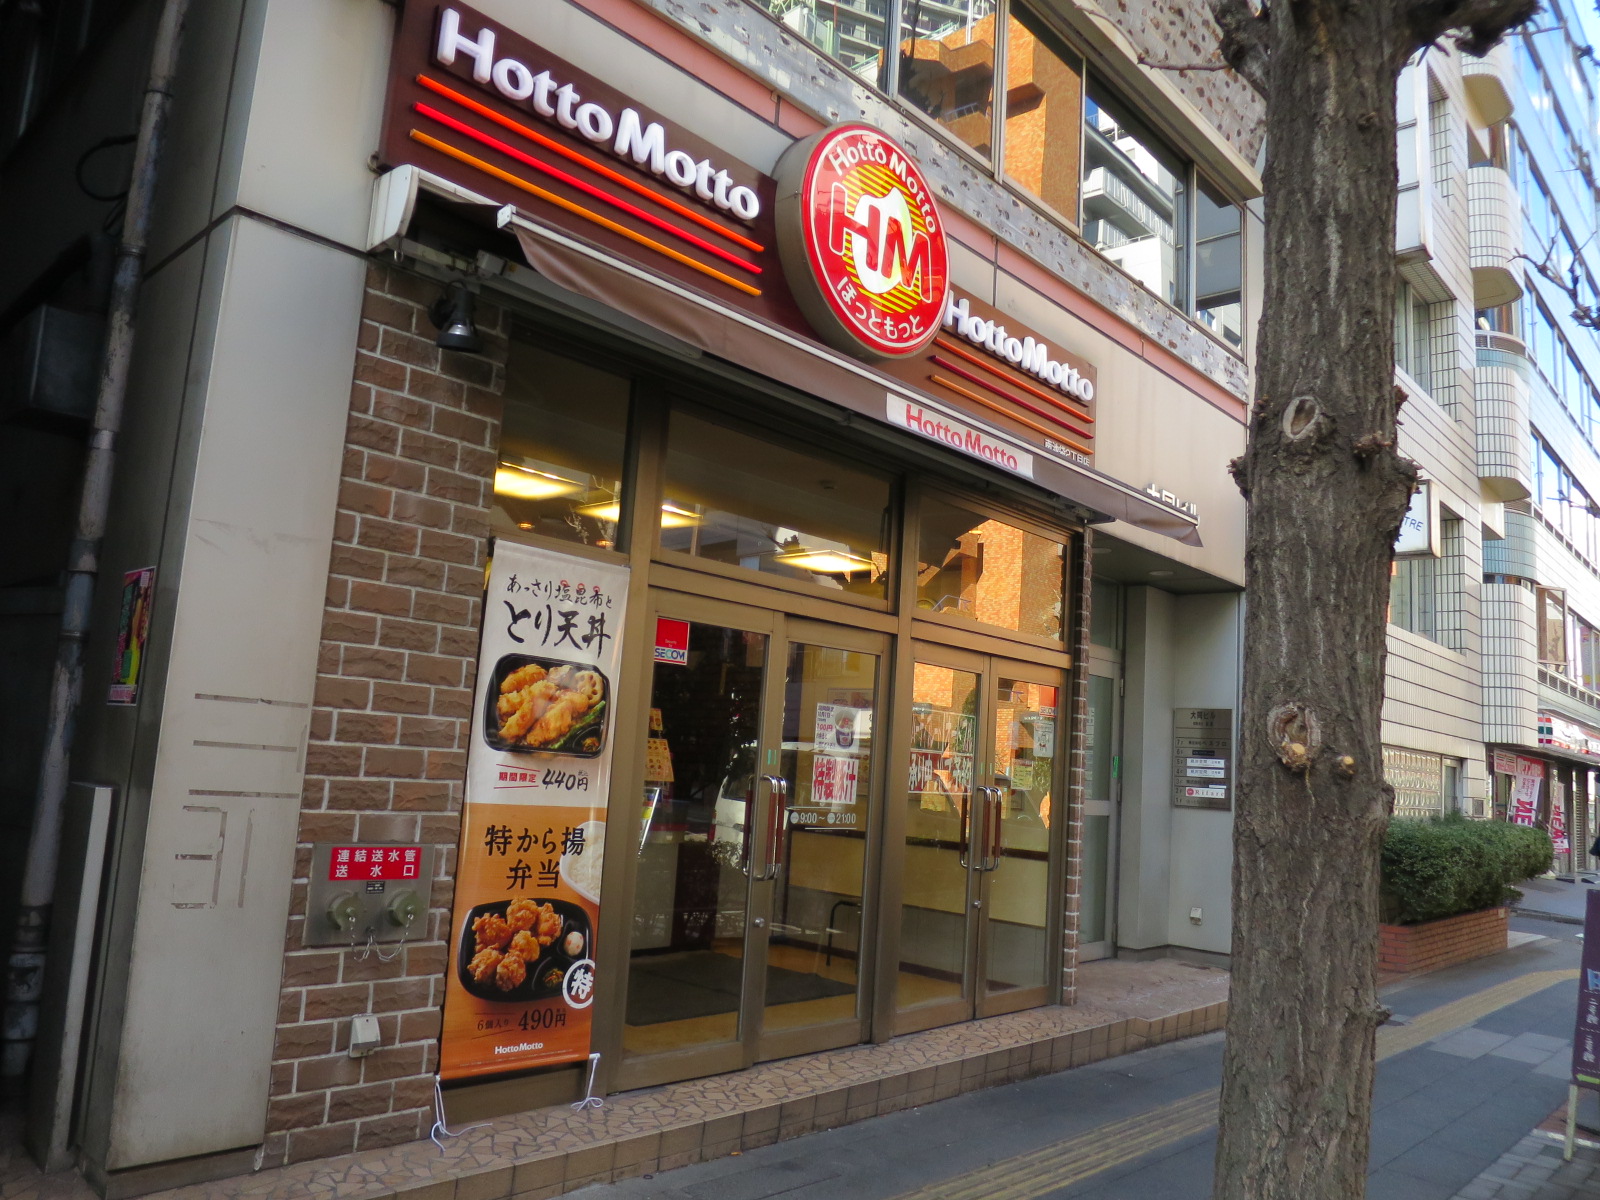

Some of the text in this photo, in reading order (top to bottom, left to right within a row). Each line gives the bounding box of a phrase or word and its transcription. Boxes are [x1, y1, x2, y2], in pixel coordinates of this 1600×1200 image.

[837, 276, 924, 339] ほっともっと
[507, 574, 612, 609] あっさり塩昆布と
[503, 600, 612, 660] とり天丼
[654, 647, 685, 661] SECOM
[800, 812, 817, 824] 9:00
[836, 812, 856, 824] 21:00
[1513, 798, 1534, 827] NE
[337, 849, 416, 862] 連結送水管
[484, 824, 586, 857] 特から揚
[506, 858, 561, 890] 弁当
[571, 968, 594, 999] 特
[518, 1008, 567, 1031] 490円
